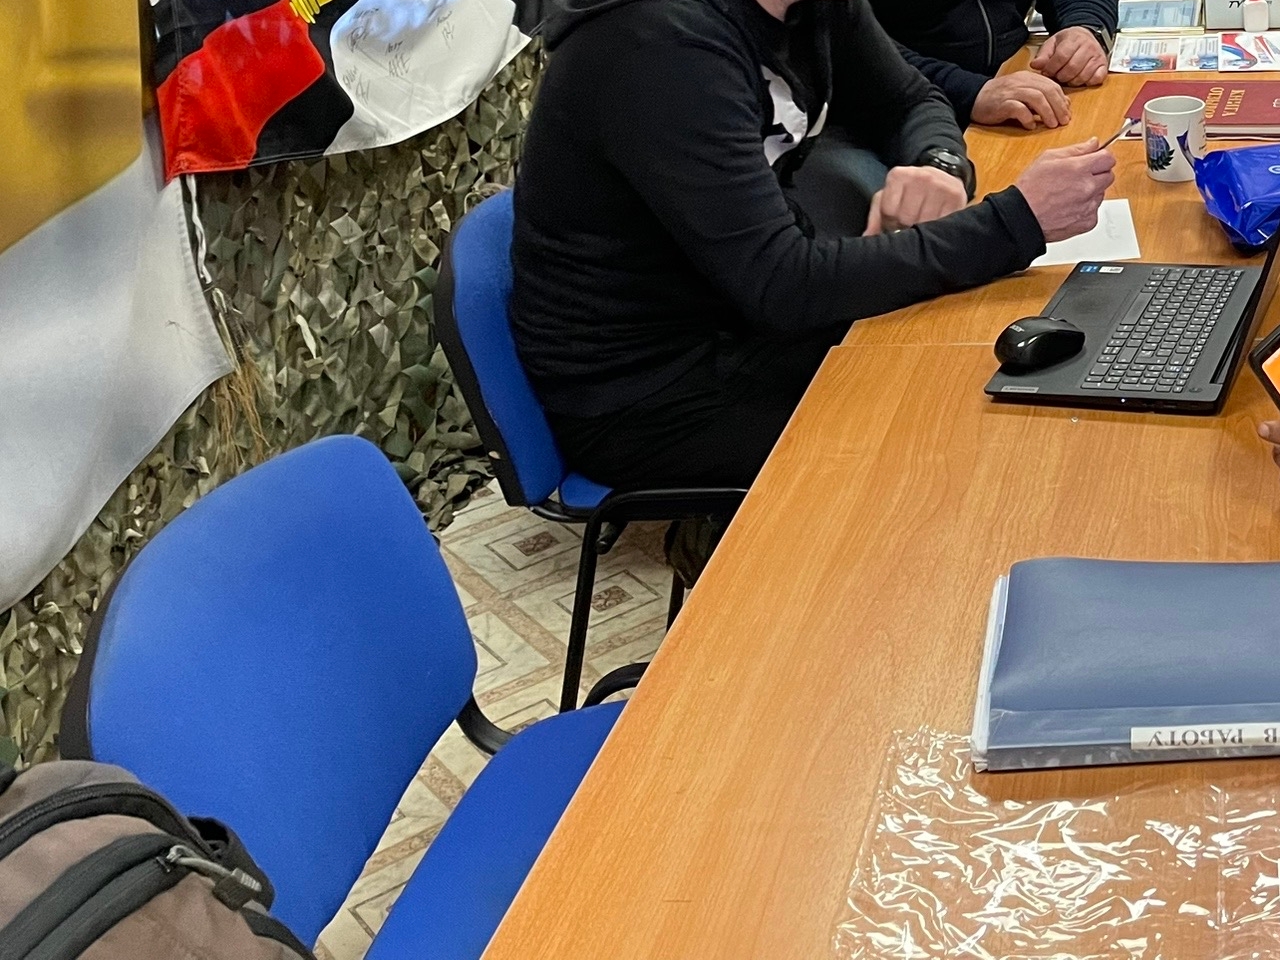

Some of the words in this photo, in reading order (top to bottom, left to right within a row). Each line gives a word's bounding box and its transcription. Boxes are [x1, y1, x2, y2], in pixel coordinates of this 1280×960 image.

[1221, 89, 1246, 117] КНИГА
[1149, 727, 1244, 748] РАБОТУ
[1263, 726, 1278, 744] В
